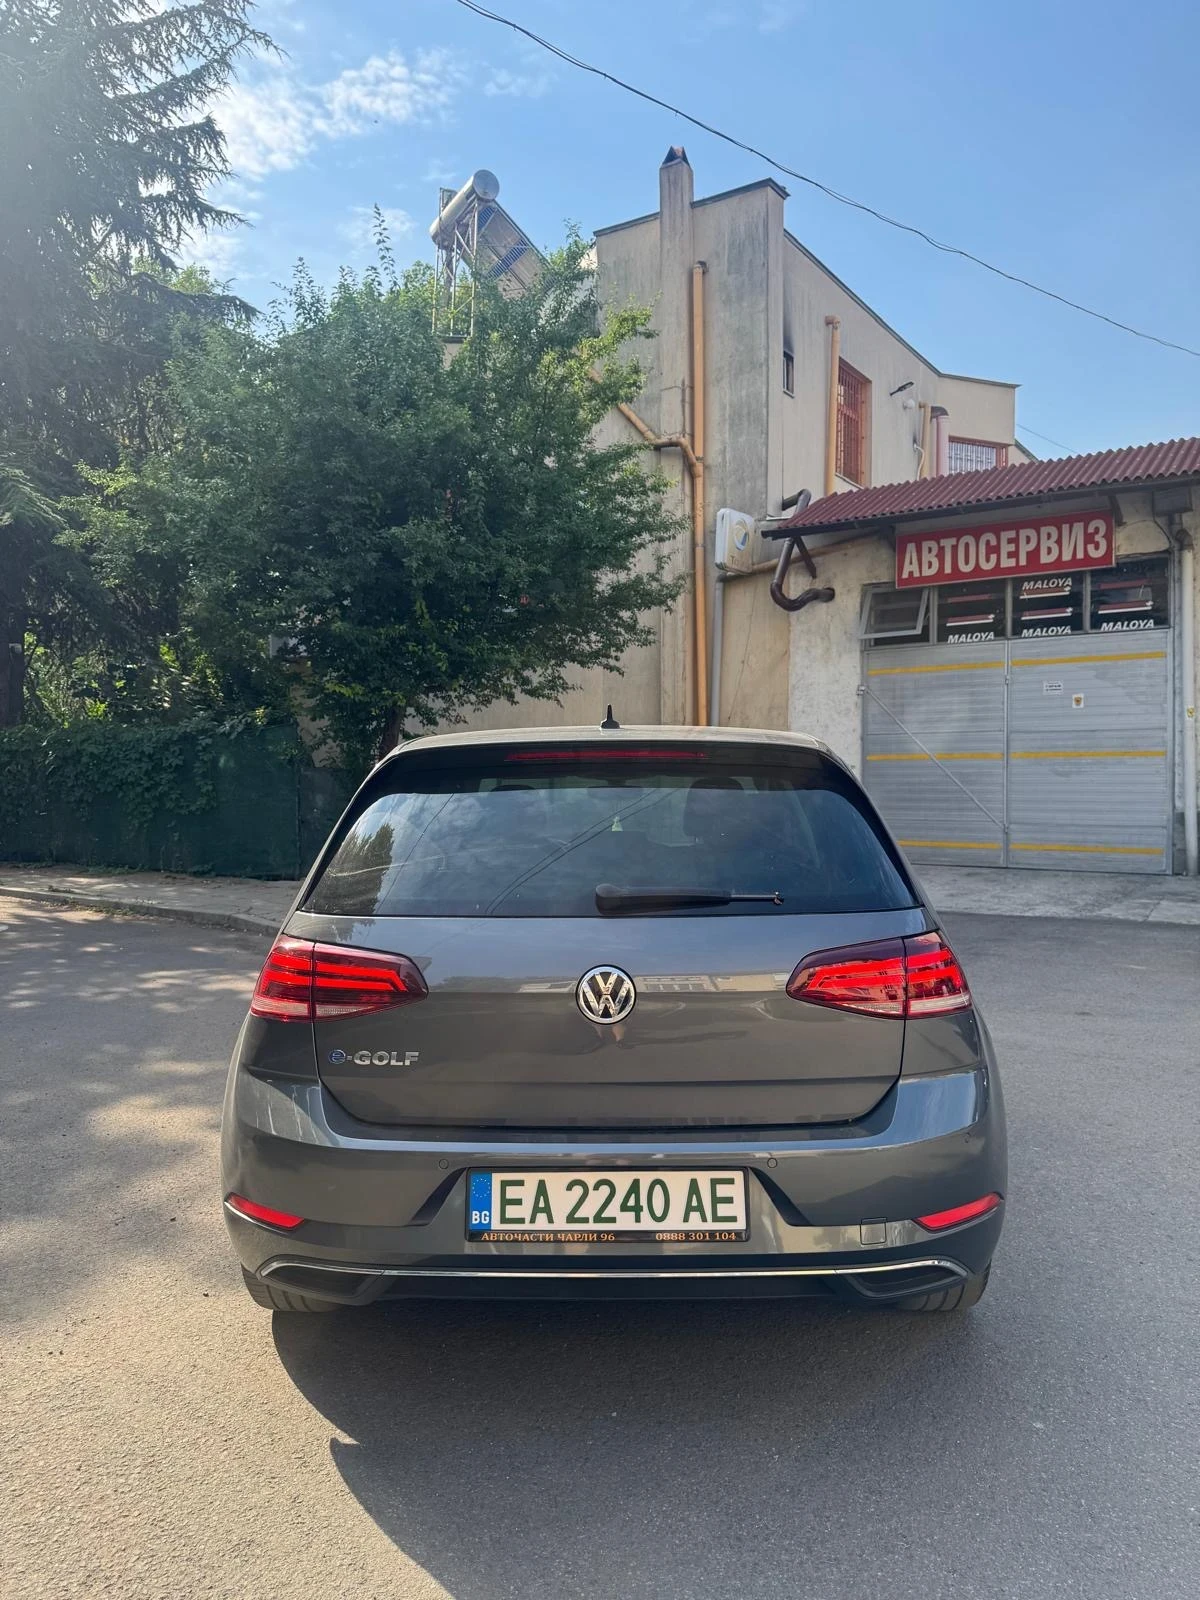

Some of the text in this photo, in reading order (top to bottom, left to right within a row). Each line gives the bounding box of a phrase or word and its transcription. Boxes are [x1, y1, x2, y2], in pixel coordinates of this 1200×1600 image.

[902, 519, 1107, 578] АВТОСЕРВИЗ
[1022, 578, 1072, 590] MALOYA
[1100, 619, 1155, 631] MALOYA
[1021, 625, 1072, 638] MALOYA
[947, 632, 995, 644] MALOYA
[500, 1178, 738, 1224] EA 2240 AE
[471, 1210, 490, 1224] BG
[481, 1232, 736, 1241] АВТОЧАСТИ ЧАРЛИ 96 0888 301 104
